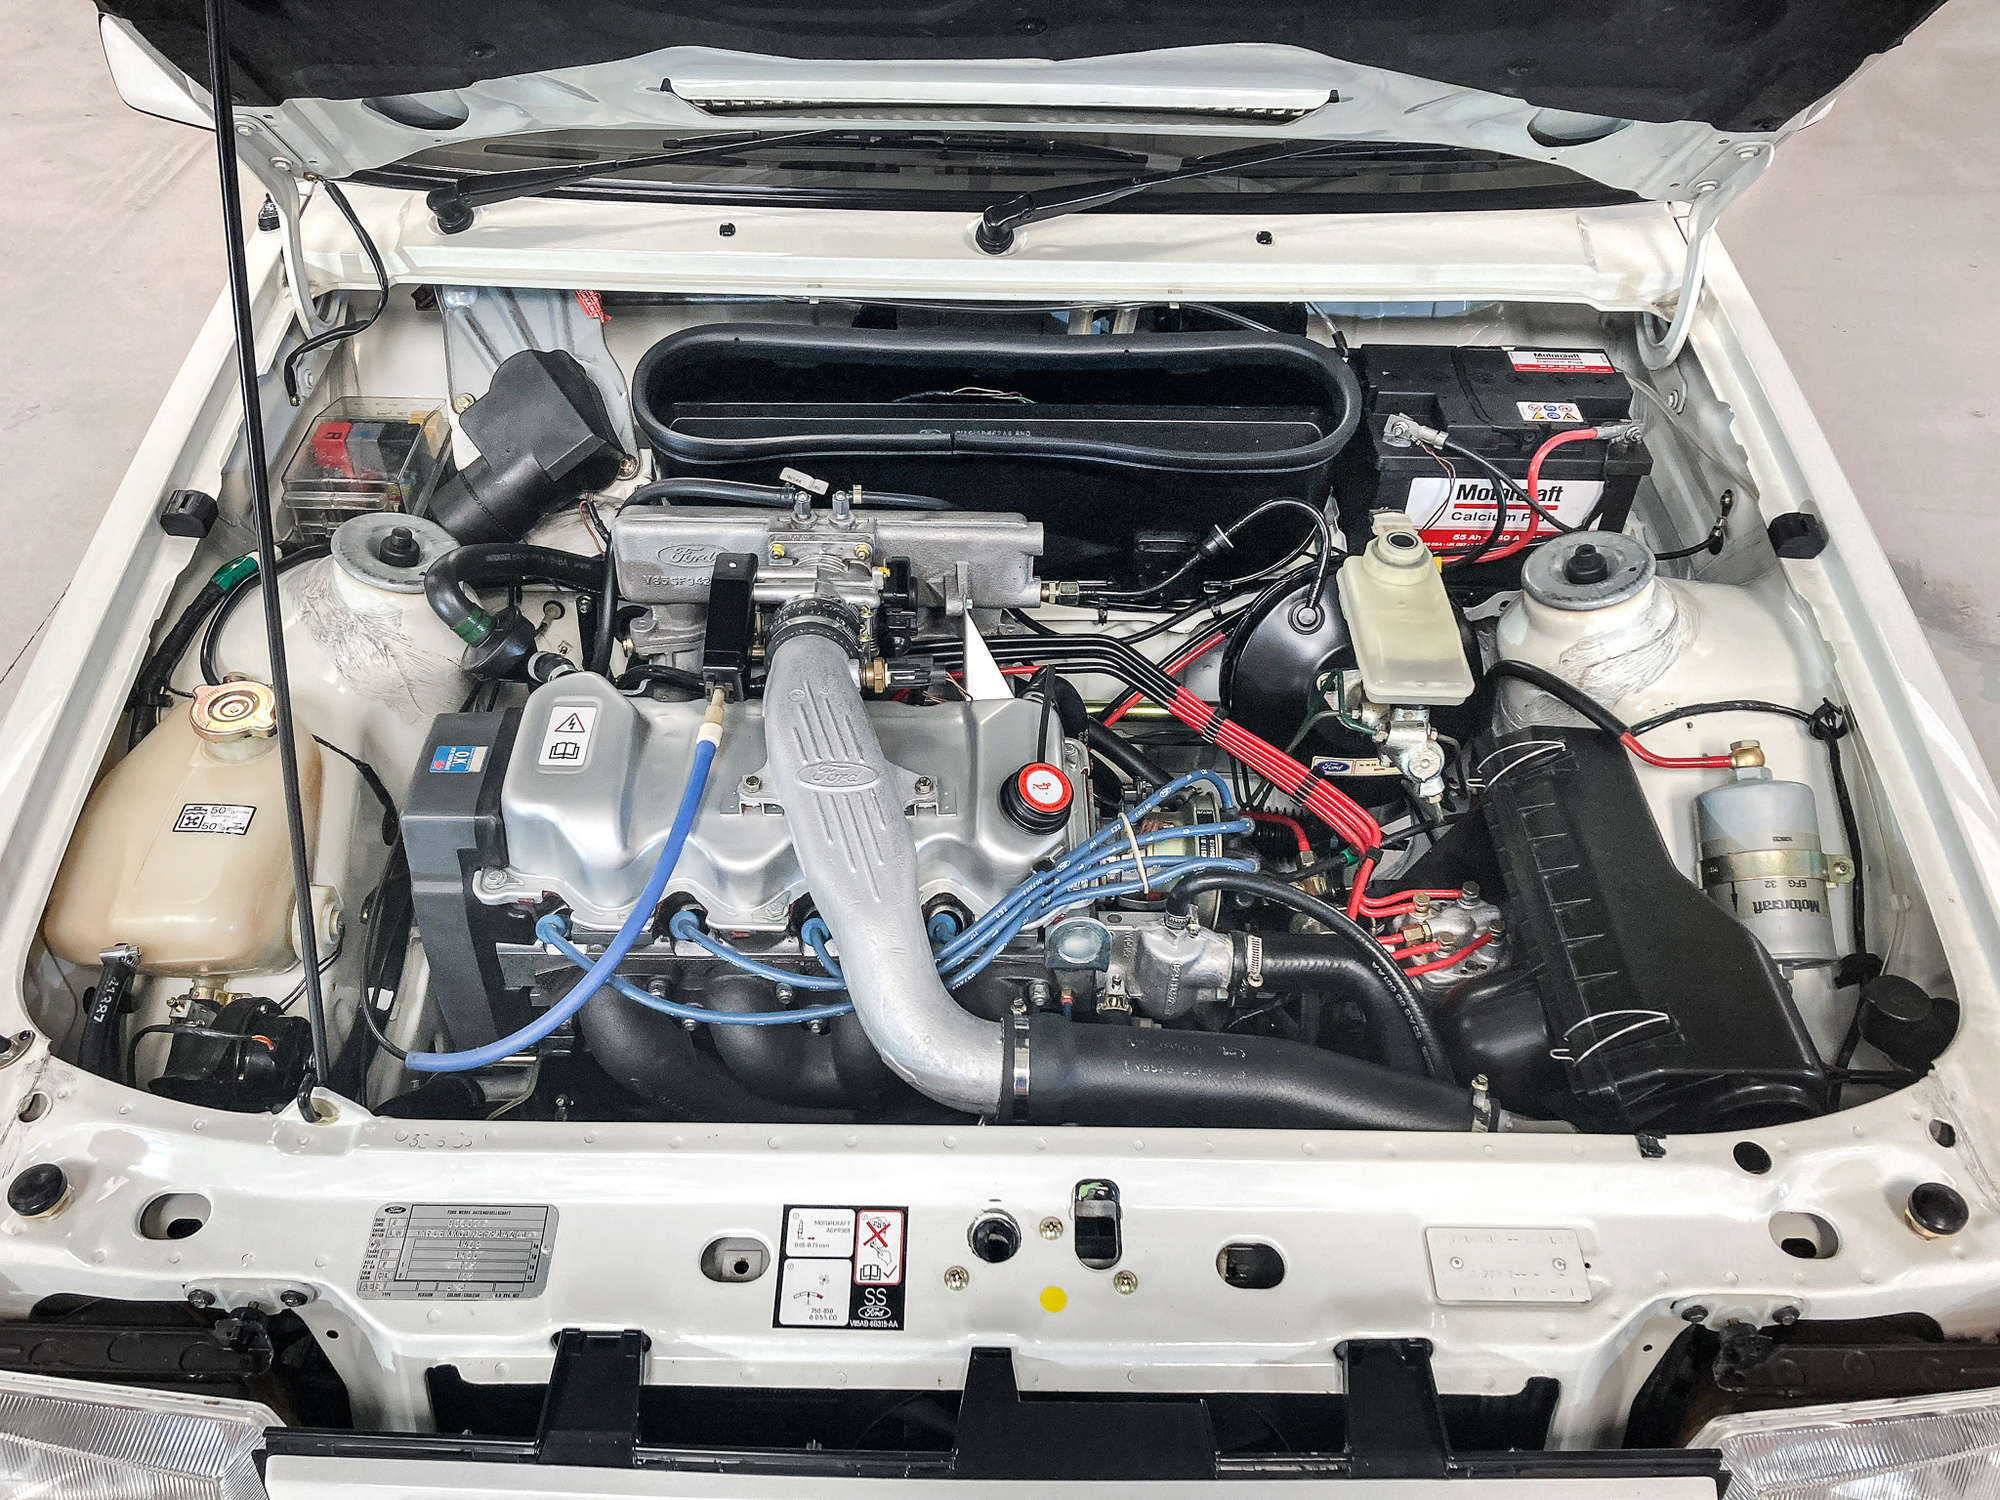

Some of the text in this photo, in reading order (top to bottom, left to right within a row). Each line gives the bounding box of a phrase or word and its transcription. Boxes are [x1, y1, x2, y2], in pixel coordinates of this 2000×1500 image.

[670, 547, 718, 564] Ford
[1321, 761, 1345, 771] Ford
[811, 764, 859, 784] Ford
[1764, 879, 1808, 888] EFG 32
[1752, 899, 1821, 914] Motorcraft
[863, 1287, 888, 1307] SS
[864, 1308, 885, 1318] Ford
